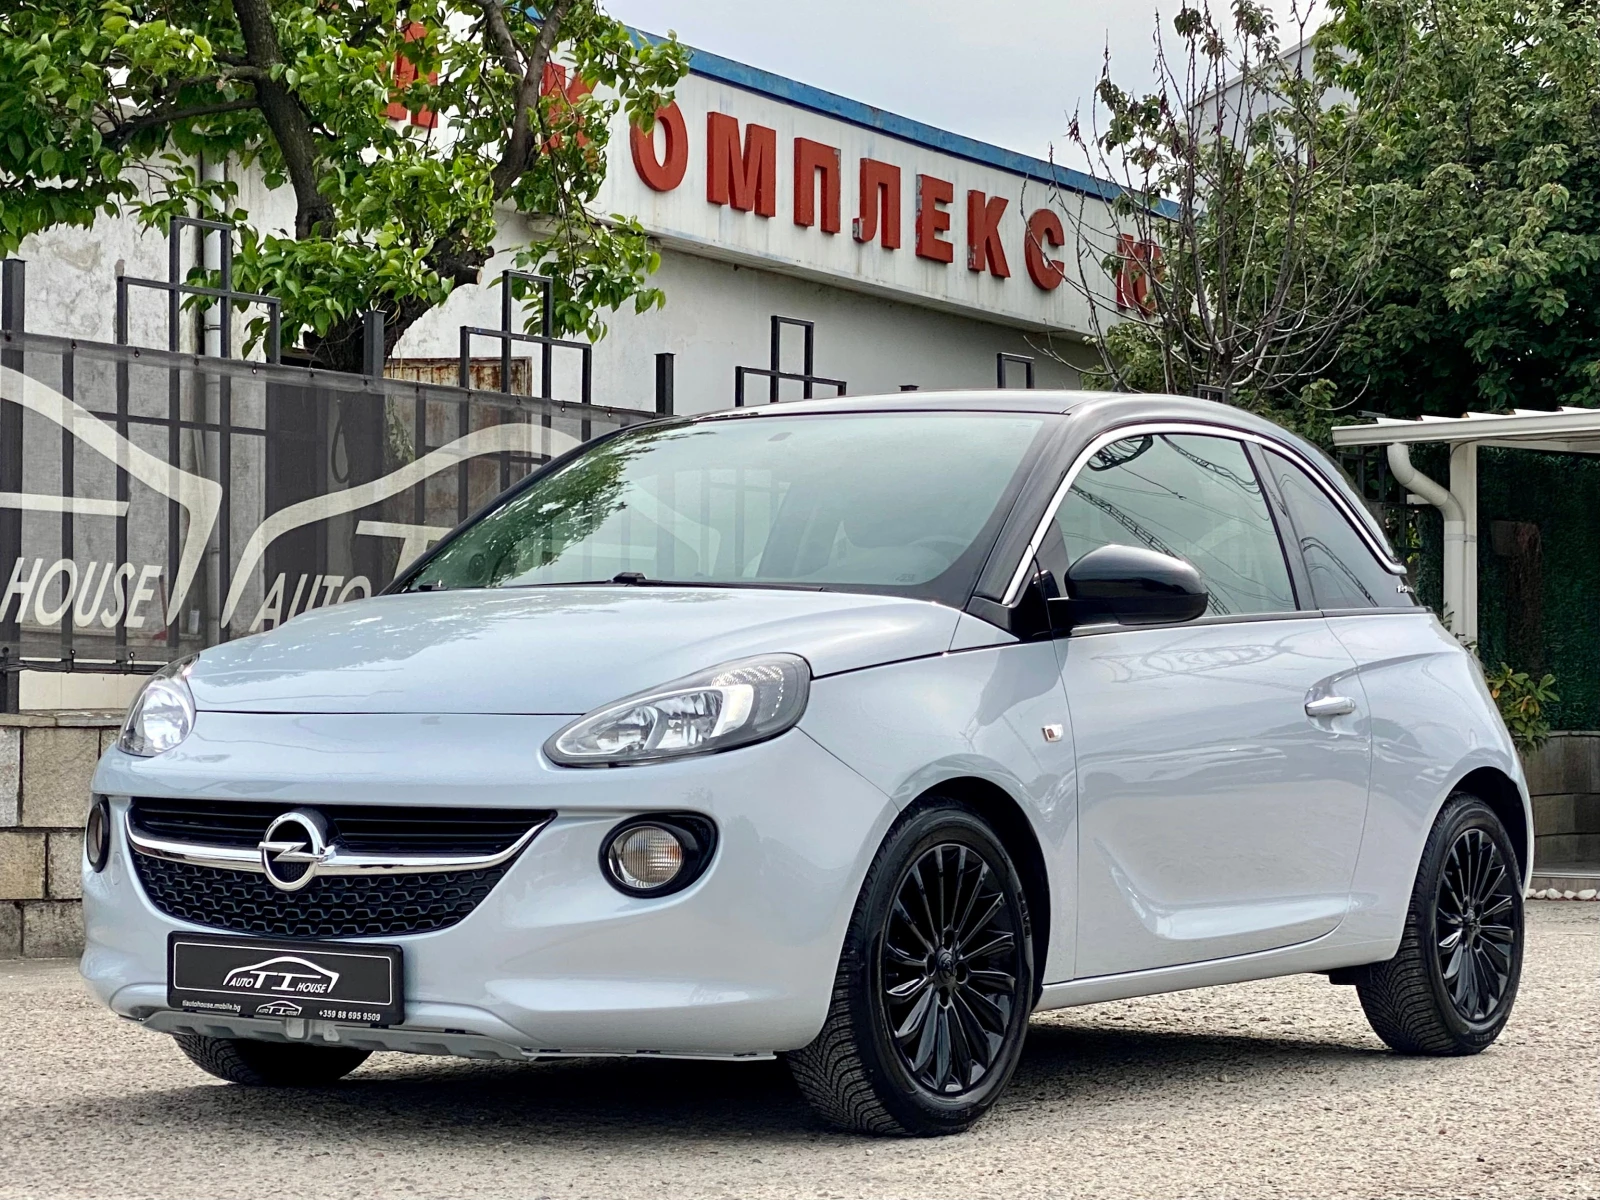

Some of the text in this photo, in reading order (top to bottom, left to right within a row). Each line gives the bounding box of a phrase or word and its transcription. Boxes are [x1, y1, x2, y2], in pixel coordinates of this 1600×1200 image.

[0, 556, 163, 629] HOUSE
[228, 977, 254, 988] AUTO
[296, 982, 328, 994] HOUSE
[318, 1009, 381, 1022] +359 88 695 9509
